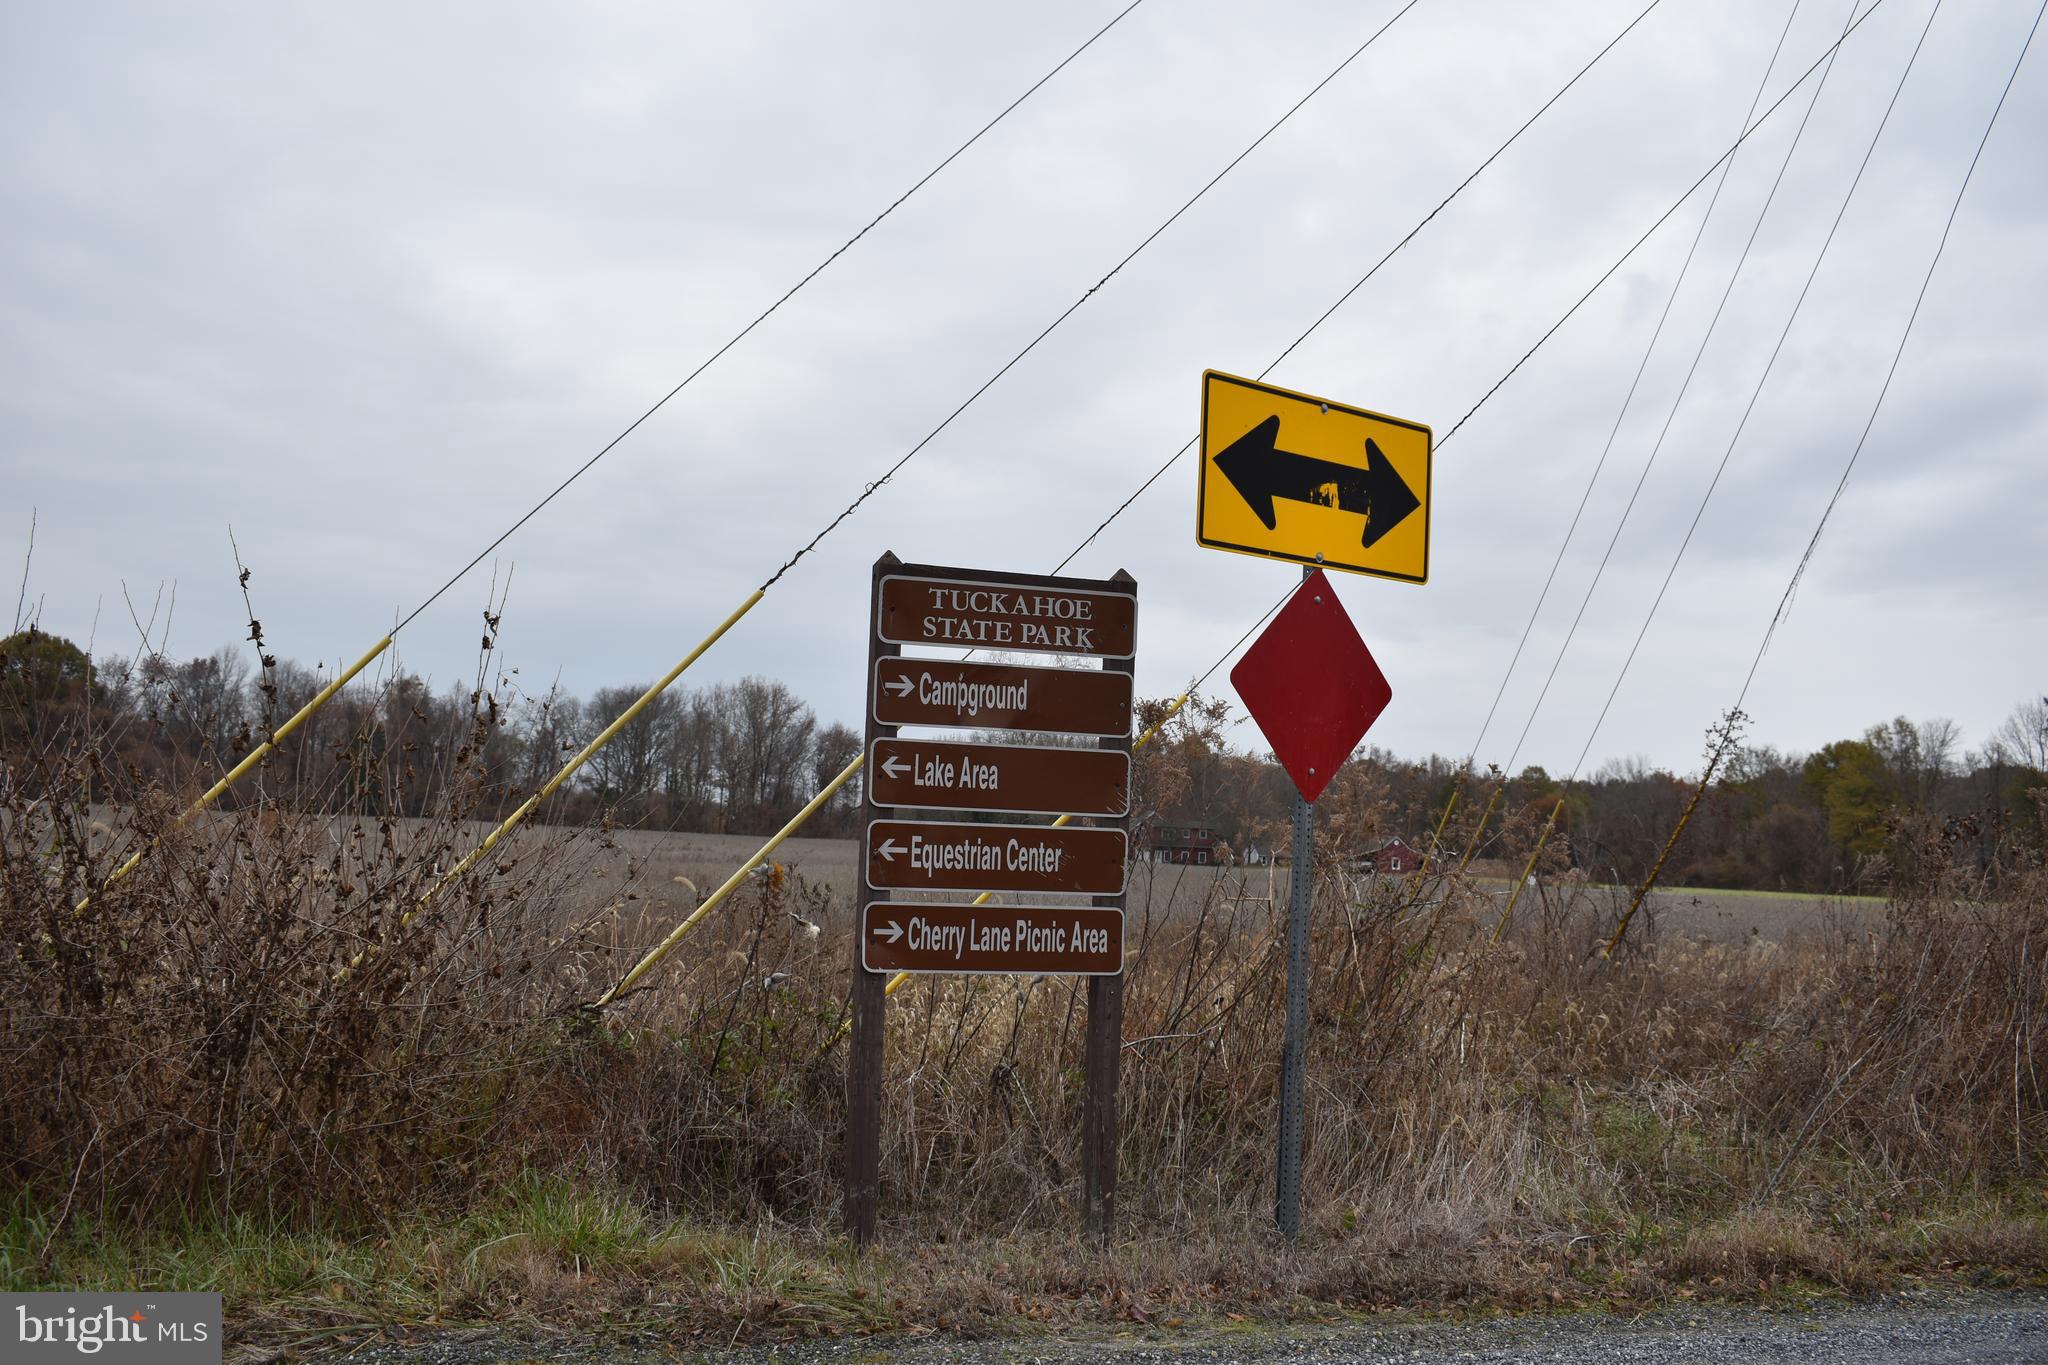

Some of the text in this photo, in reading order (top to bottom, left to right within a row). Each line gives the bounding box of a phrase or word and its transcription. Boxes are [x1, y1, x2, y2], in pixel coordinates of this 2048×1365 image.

[929, 587, 1092, 620] TUCKAHOE
[923, 616, 1095, 649] STATE PARK
[919, 671, 1028, 716] Campground
[914, 753, 998, 789] Lake Area
[911, 835, 1062, 877] Equestrian Center
[907, 916, 1108, 959] Cherry Lane Picnic Area
